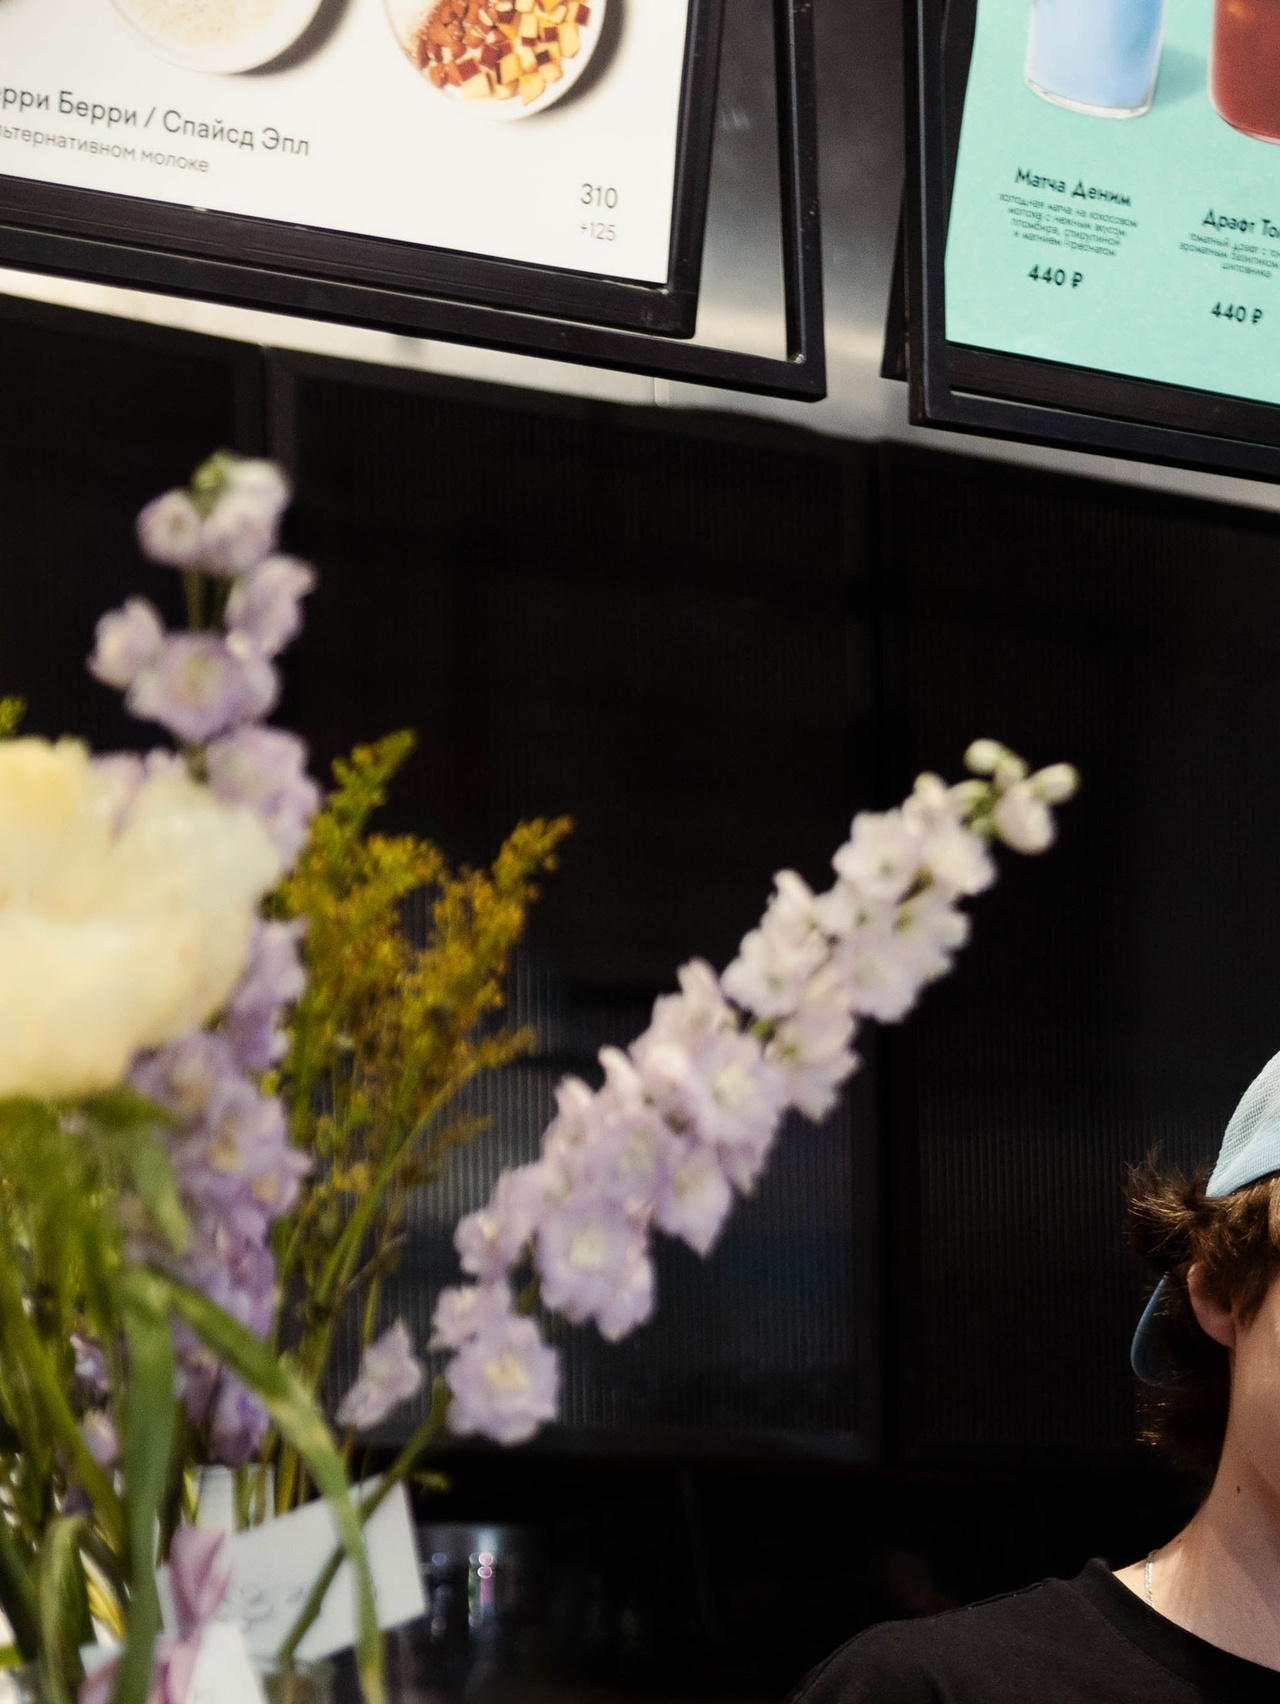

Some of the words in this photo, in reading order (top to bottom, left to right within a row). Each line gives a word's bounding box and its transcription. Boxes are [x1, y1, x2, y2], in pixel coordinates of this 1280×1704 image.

[0, 86, 49, 112] рри
[58, 90, 138, 128] Берри
[162, 109, 256, 150] Спайсд
[260, 126, 311, 156] Эпл
[0, 124, 136, 158] ьтернативном
[139, 148, 210, 173] молоке
[579, 182, 619, 209] 310
[1014, 166, 1067, 194] Матча
[1071, 177, 1133, 206] Деним
[579, 221, 617, 242] +125
[1201, 207, 1256, 233] Драфт
[1027, 263, 1067, 286] 440
[1071, 271, 1084, 289] ₽
[1211, 301, 1247, 323] 440
[1252, 308, 1264, 326] ₽
